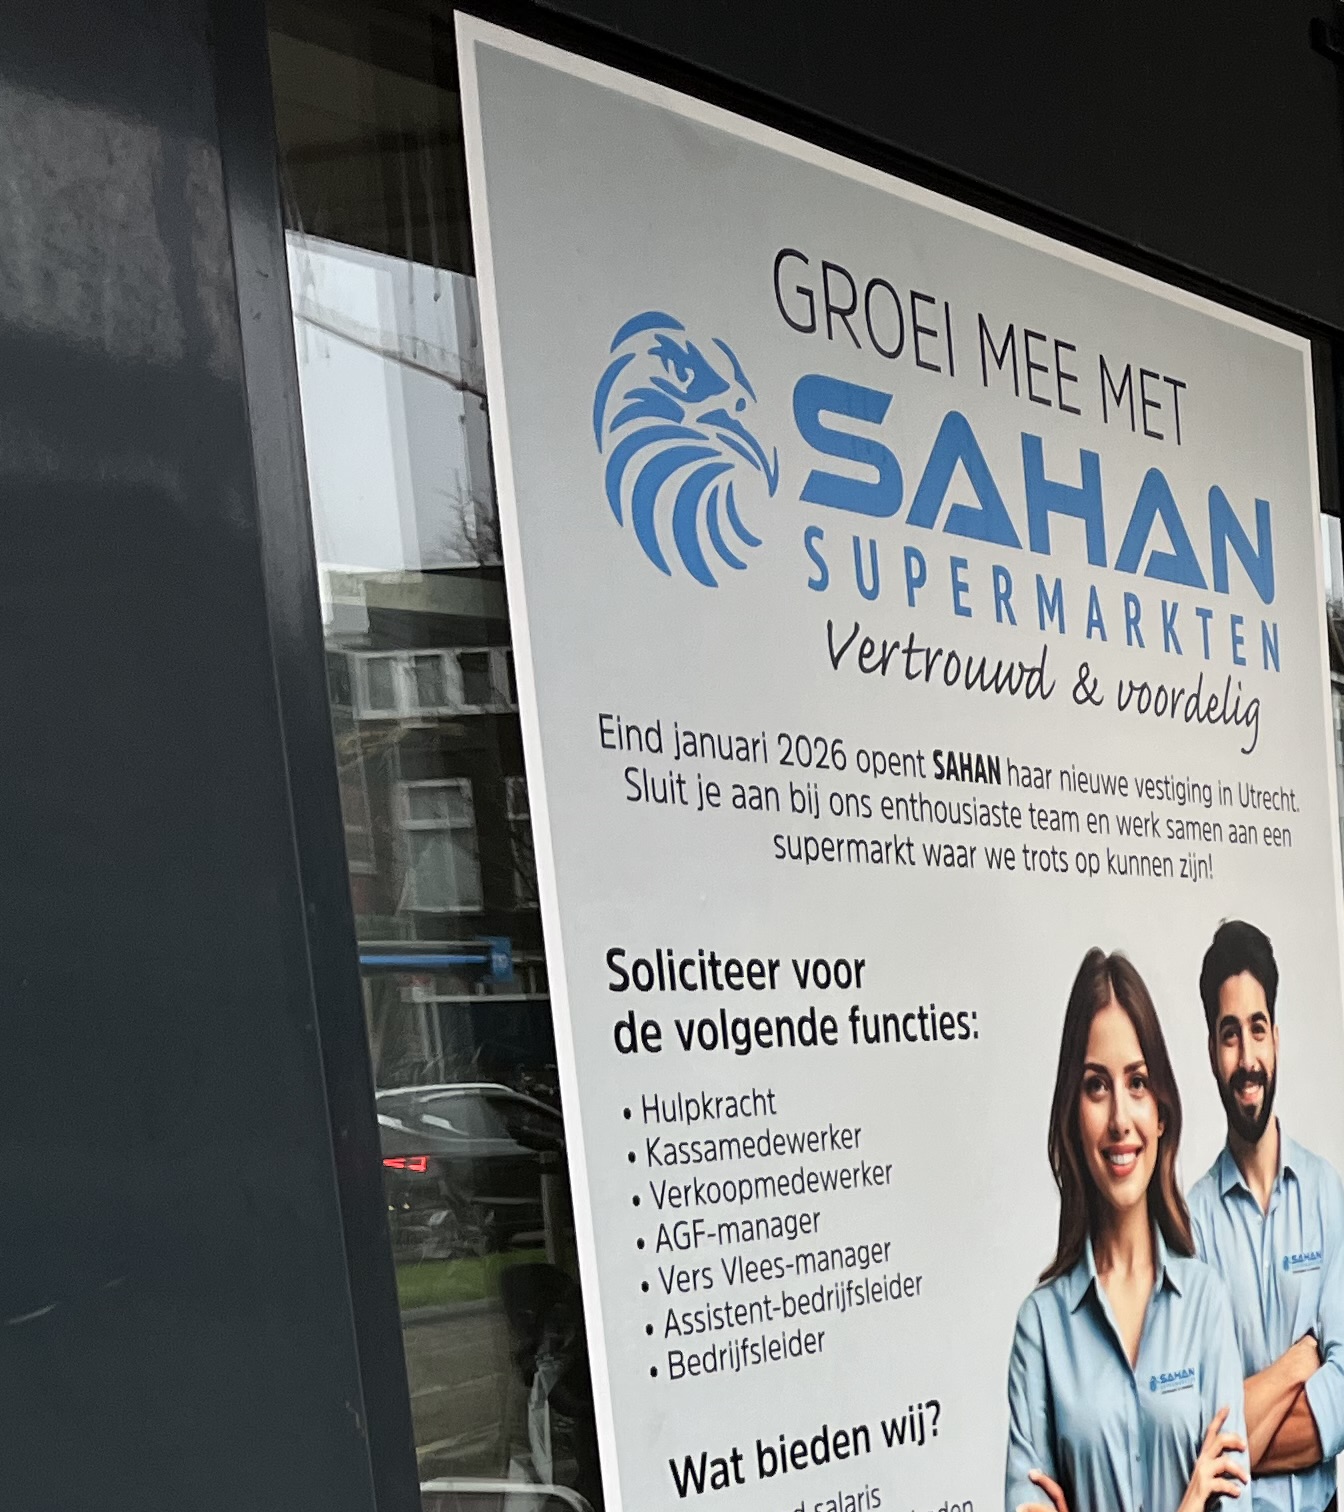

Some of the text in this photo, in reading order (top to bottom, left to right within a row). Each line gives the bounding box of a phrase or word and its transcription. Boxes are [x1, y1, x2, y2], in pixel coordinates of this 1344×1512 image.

[773, 247, 1187, 447] GROEI MEE MET
[792, 373, 1275, 606] SAHAN
[803, 525, 1281, 673] SUPERMARKTEN
[826, 619, 1262, 756] Vertrouwd & voordelig
[598, 712, 1301, 813] Eind januari 2026 opent SAHAN haar nieuwe vestiging in Utrecht.
[624, 765, 1292, 848] Sluit je aan bij ons enthousiaste team en werk samen aan een
[773, 833, 1214, 883] supermarkt waar we trots op kunnen zijn!
[605, 946, 866, 993] Soliciteer voor
[613, 1002, 979, 1057] de volgende functies:
[641, 1087, 778, 1127] Hulpkracht
[645, 1122, 862, 1168] Kassamedewerker
[648, 1159, 893, 1211] Verkoopmedewerker
[655, 1211, 821, 1254] AGF-manager
[657, 1241, 892, 1296] Vers Vlees-manager
[664, 1271, 923, 1340] Assistent-bedrijfsleider
[667, 1327, 826, 1381] Bedrijfsleider
[667, 1399, 941, 1500] Wat bieden wij?
